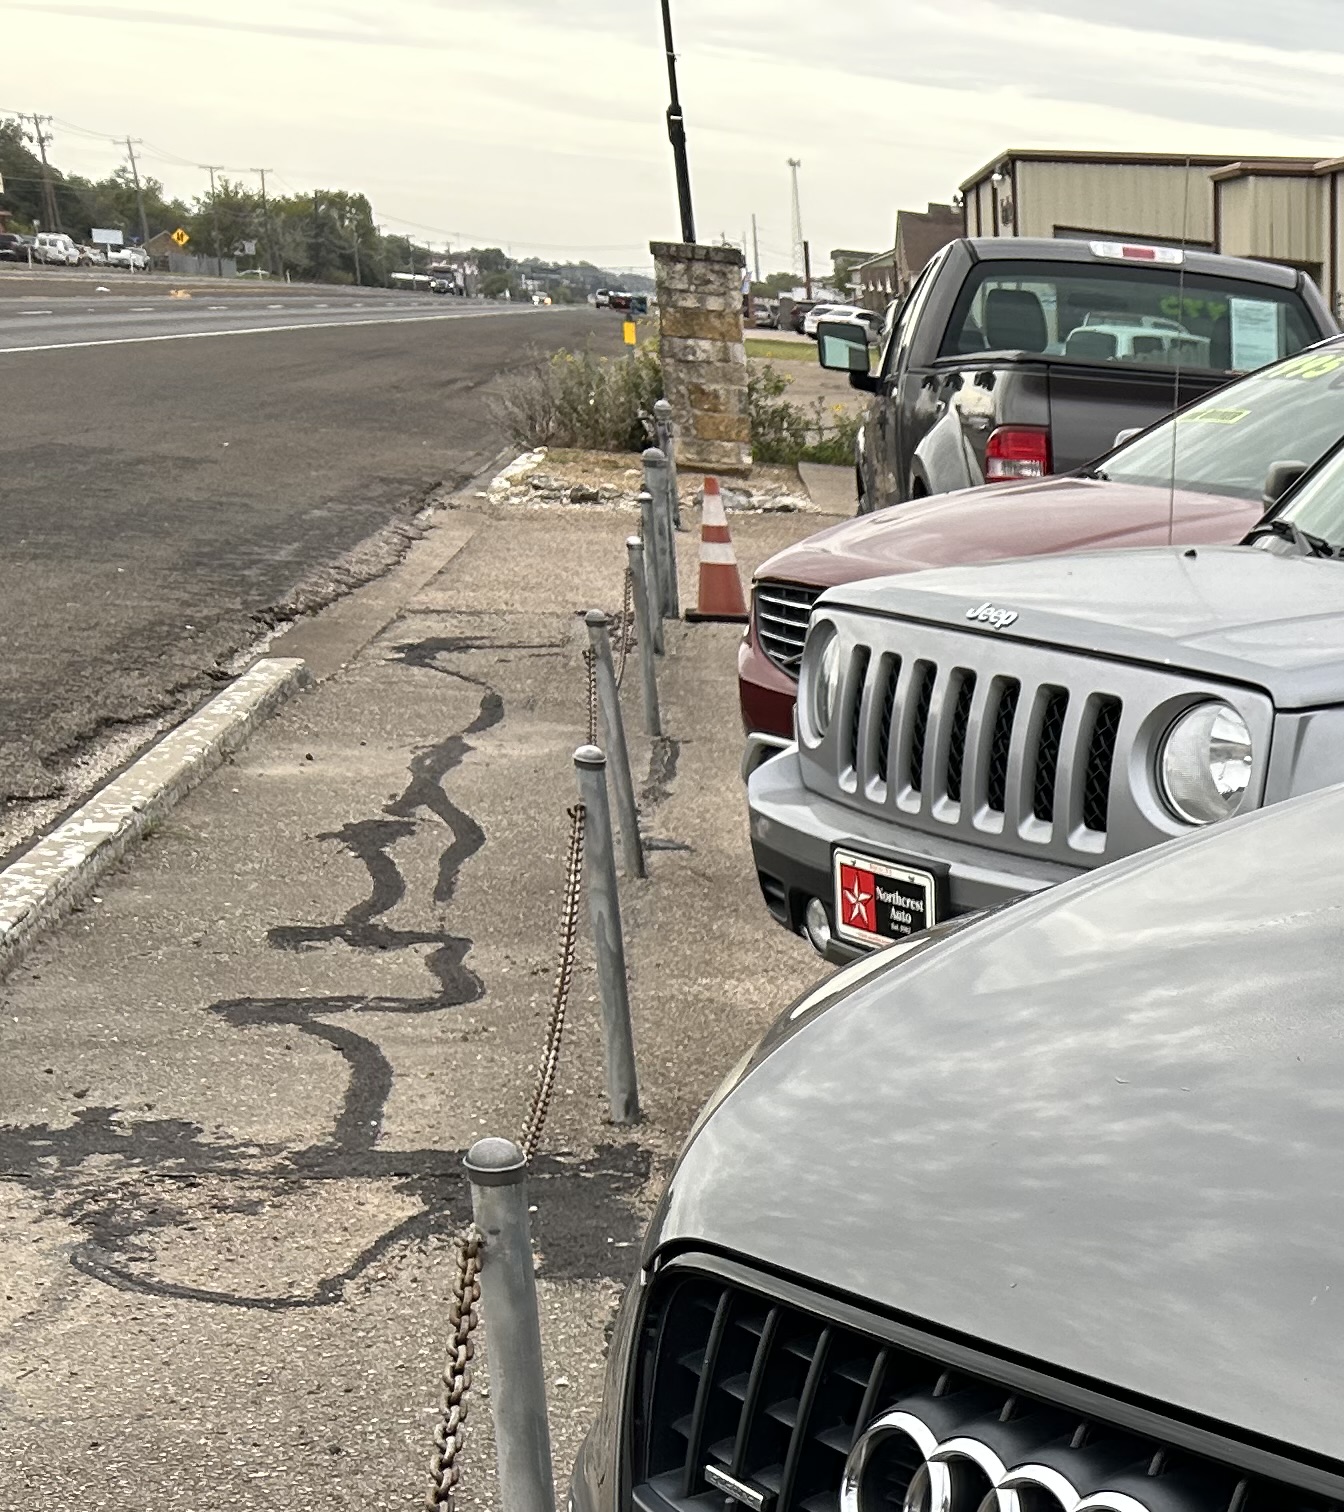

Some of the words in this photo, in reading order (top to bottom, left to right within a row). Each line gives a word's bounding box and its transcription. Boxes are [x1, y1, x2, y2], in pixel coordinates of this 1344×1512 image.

[965, 602, 1019, 630] Jeep
[876, 885, 924, 913] Northcrest
[889, 905, 912, 925] Auto
